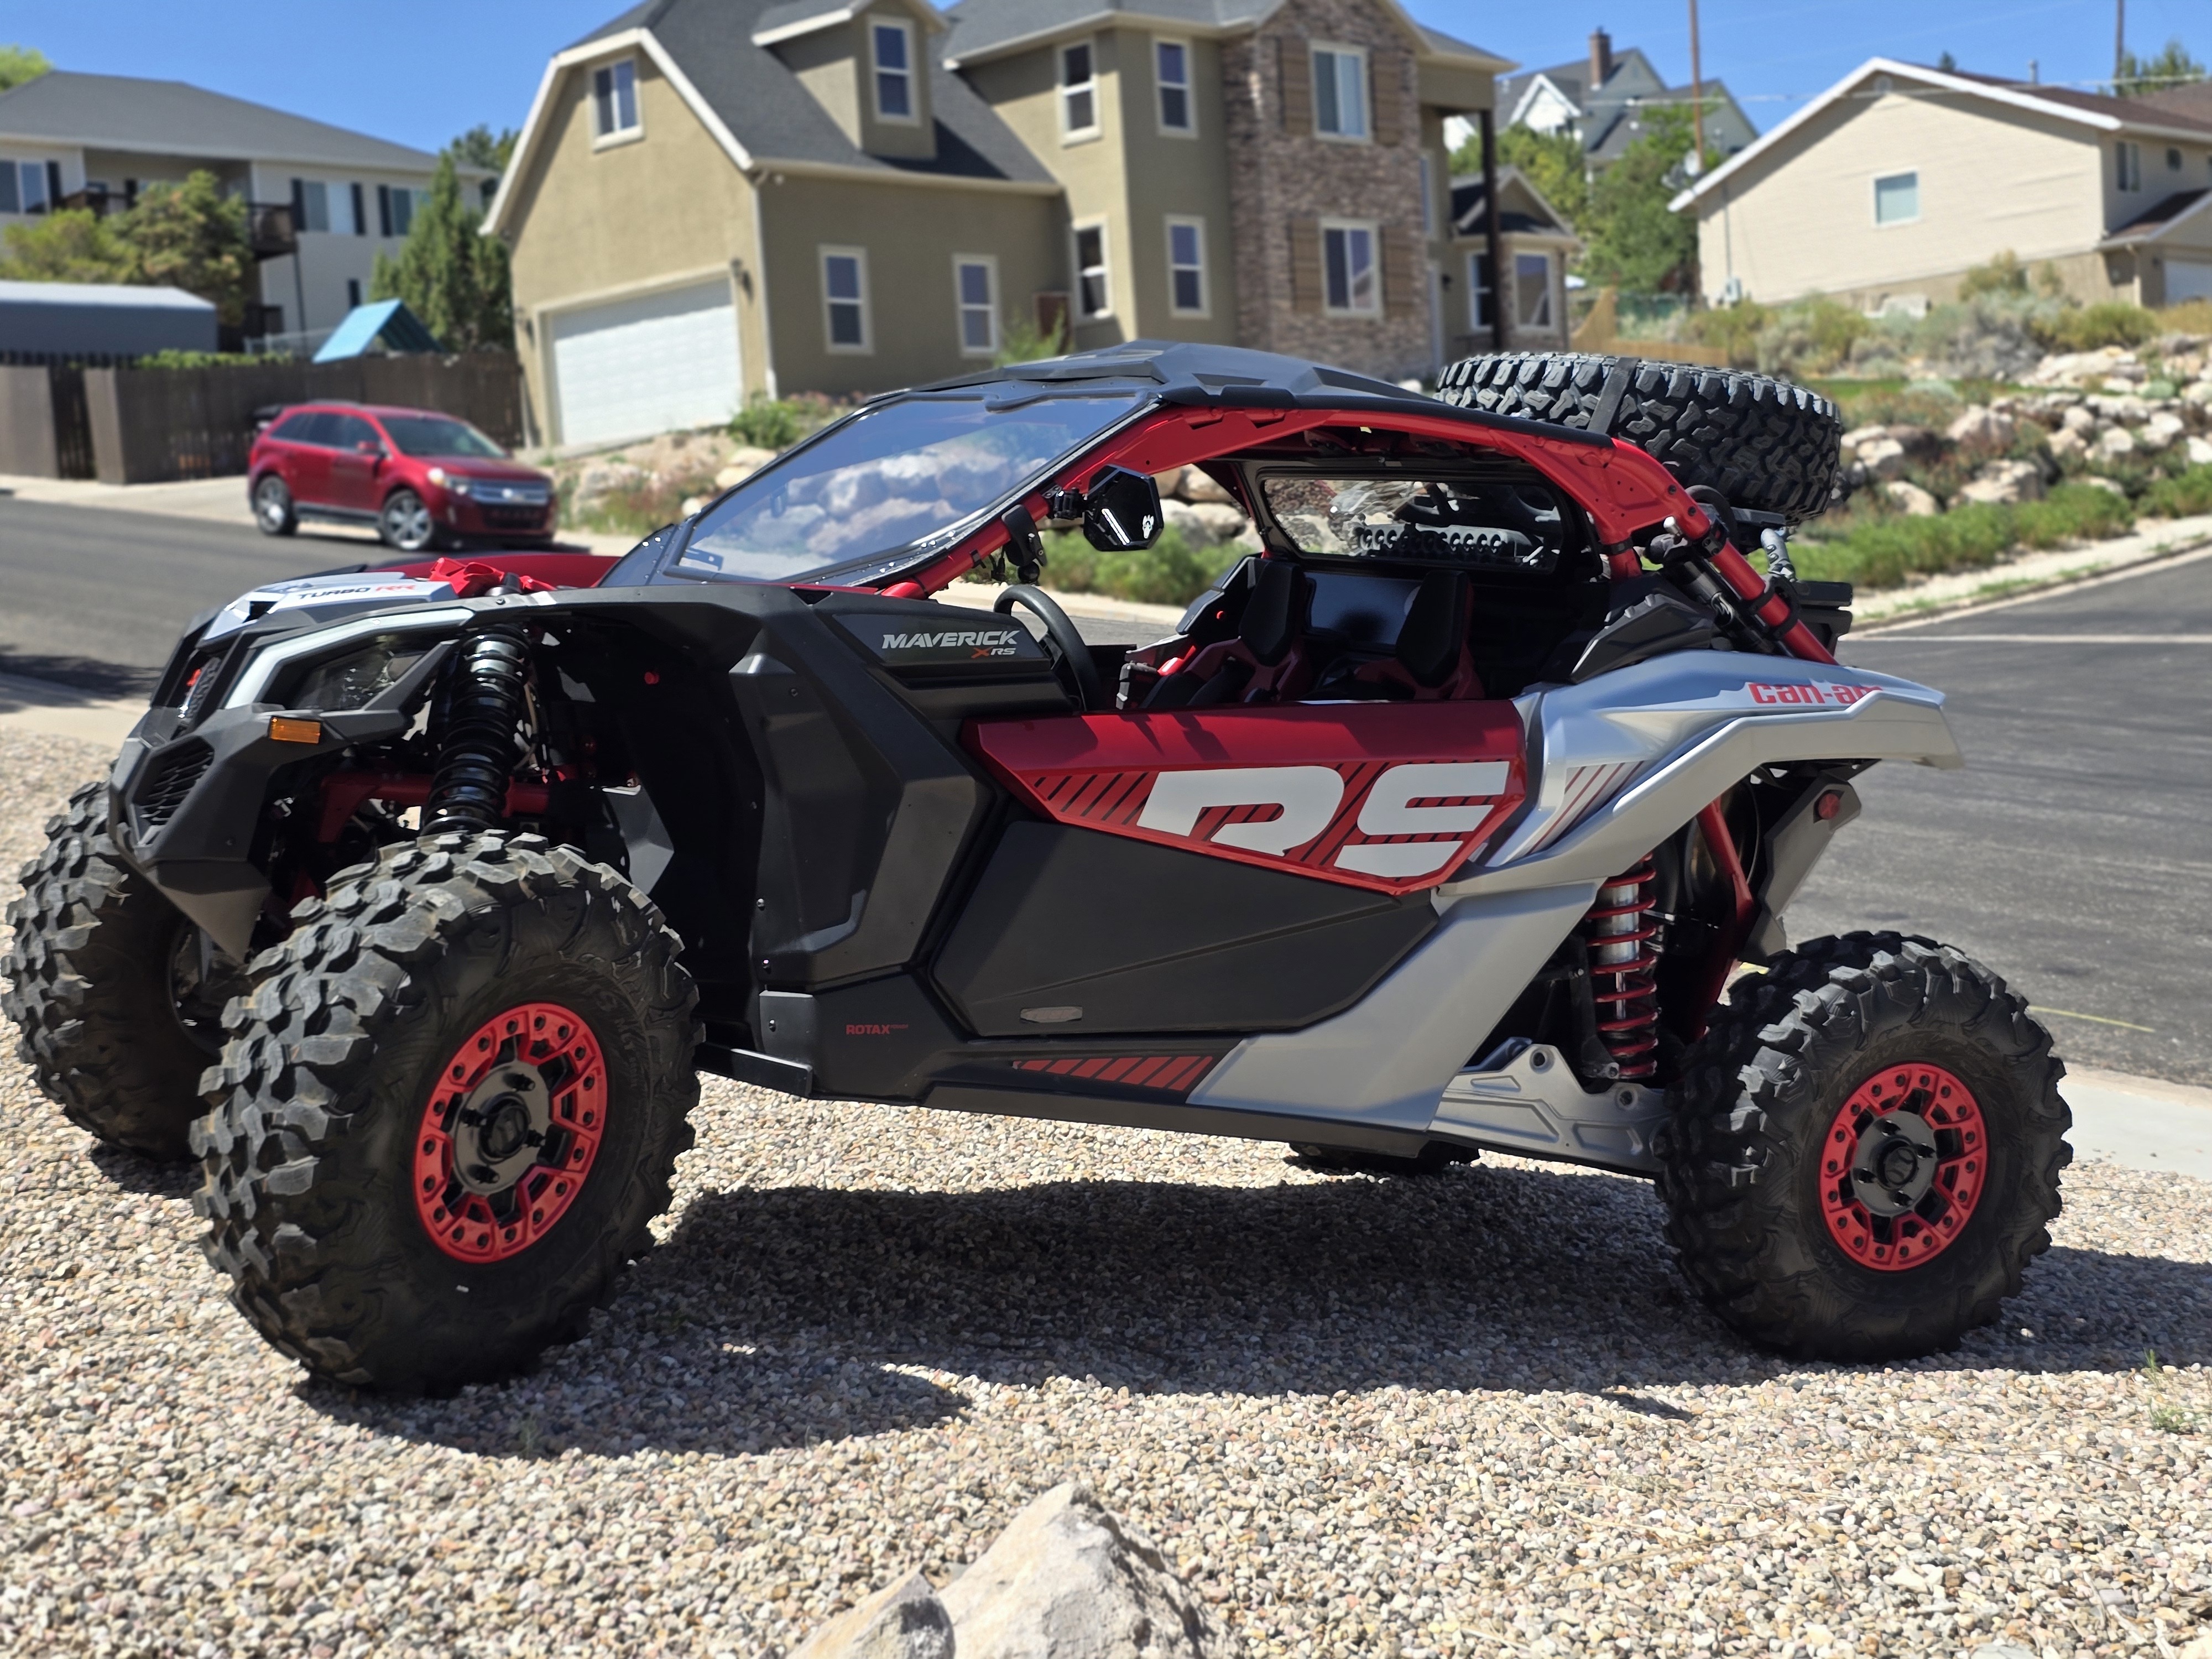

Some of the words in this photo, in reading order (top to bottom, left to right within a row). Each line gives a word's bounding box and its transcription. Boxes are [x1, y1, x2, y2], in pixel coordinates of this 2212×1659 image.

[299, 587, 371, 599] TURBO
[881, 630, 1020, 649] MAVERICK
[1136, 760, 1510, 878] RS
[846, 1024, 890, 1035] ROTAX
